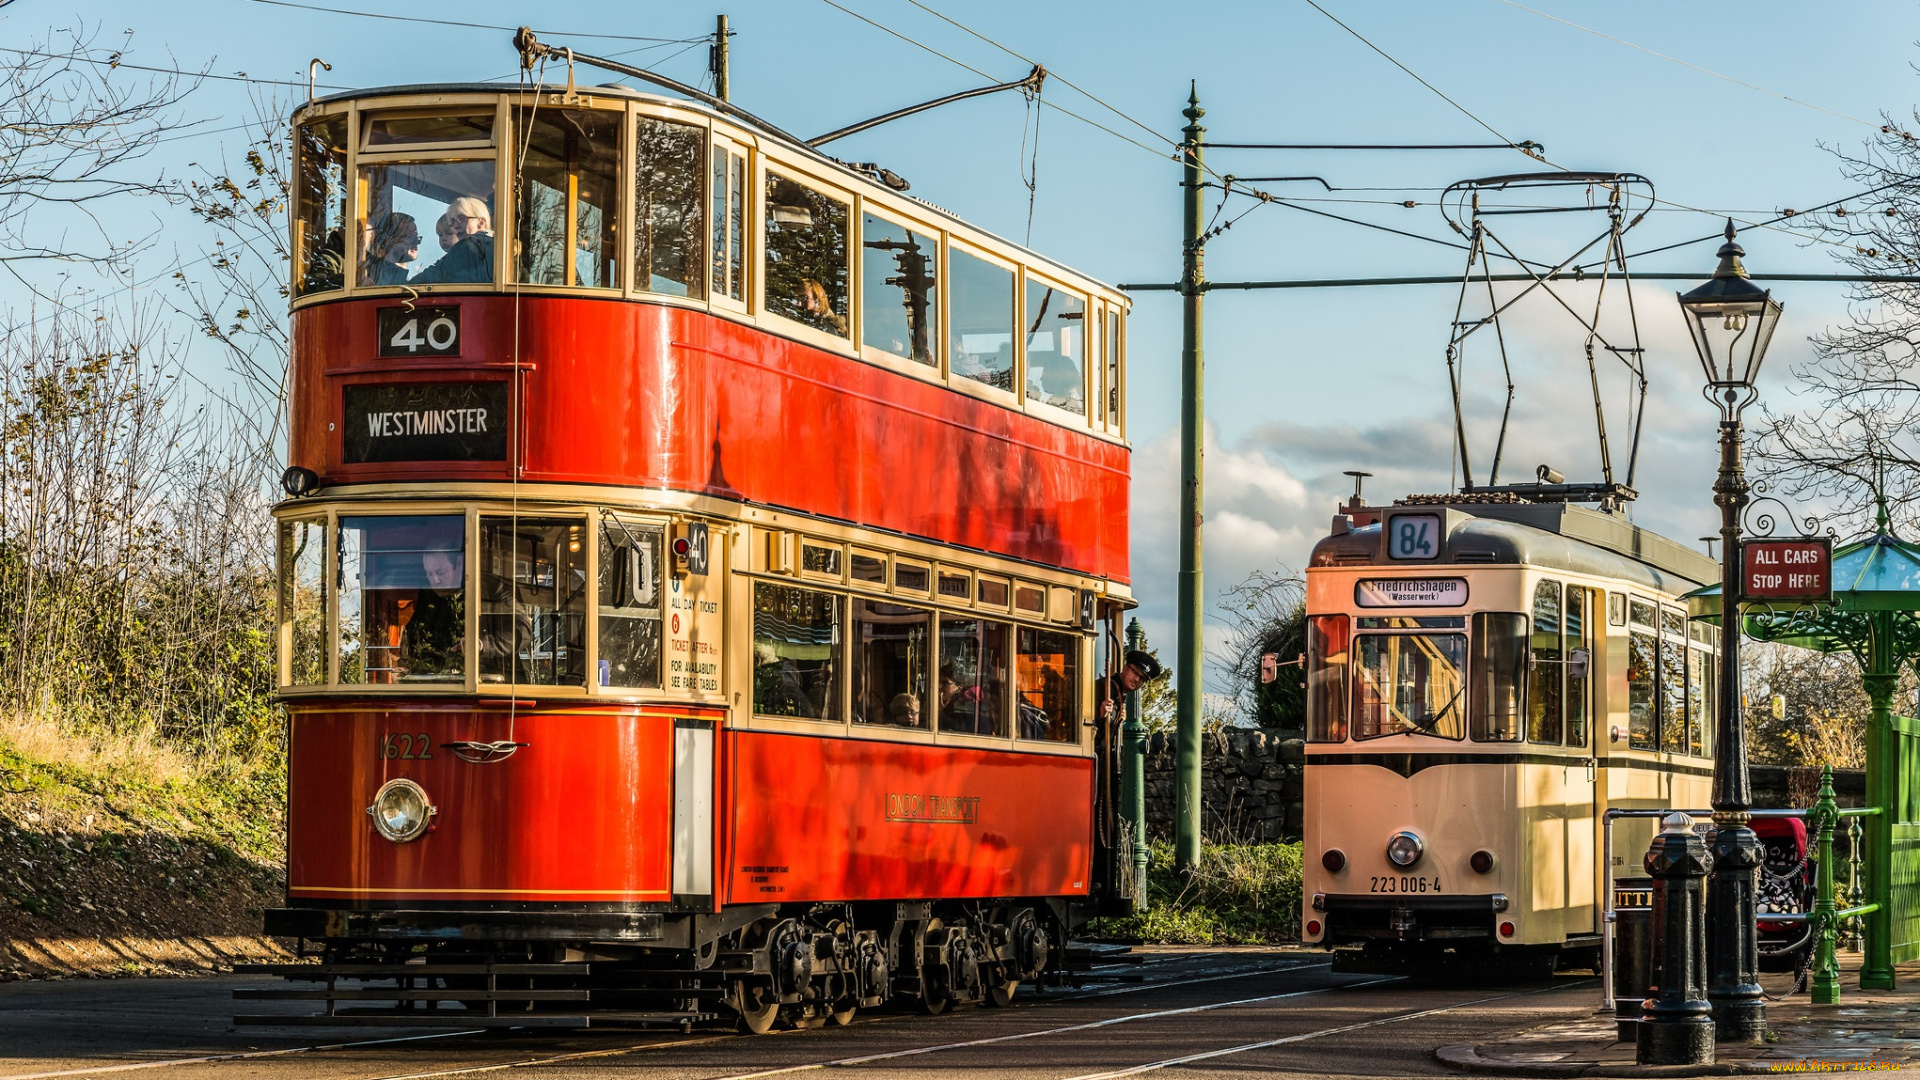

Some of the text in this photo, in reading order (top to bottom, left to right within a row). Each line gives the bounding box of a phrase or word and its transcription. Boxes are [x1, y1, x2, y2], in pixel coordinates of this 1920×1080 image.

[390, 317, 457, 353] 40
[367, 408, 488, 437] WESTMINSTER
[1400, 522, 1431, 555] 84
[689, 528, 708, 570] 40
[1755, 549, 1818, 565] ALL CARS
[1752, 573, 1820, 589] STOP HERE
[671, 597, 718, 614] ALL DAY TICKET
[671, 639, 689, 652] TICKET
[692, 641, 708, 654] AFTER
[671, 660, 717, 675] FOR AVAILABILITY
[671, 676, 718, 691] SEE FARE TABLES
[378, 732, 434, 760] 1622
[885, 792, 981, 825] LONDON TRANSPORT
[1370, 876, 1441, 893] 223 006-4
